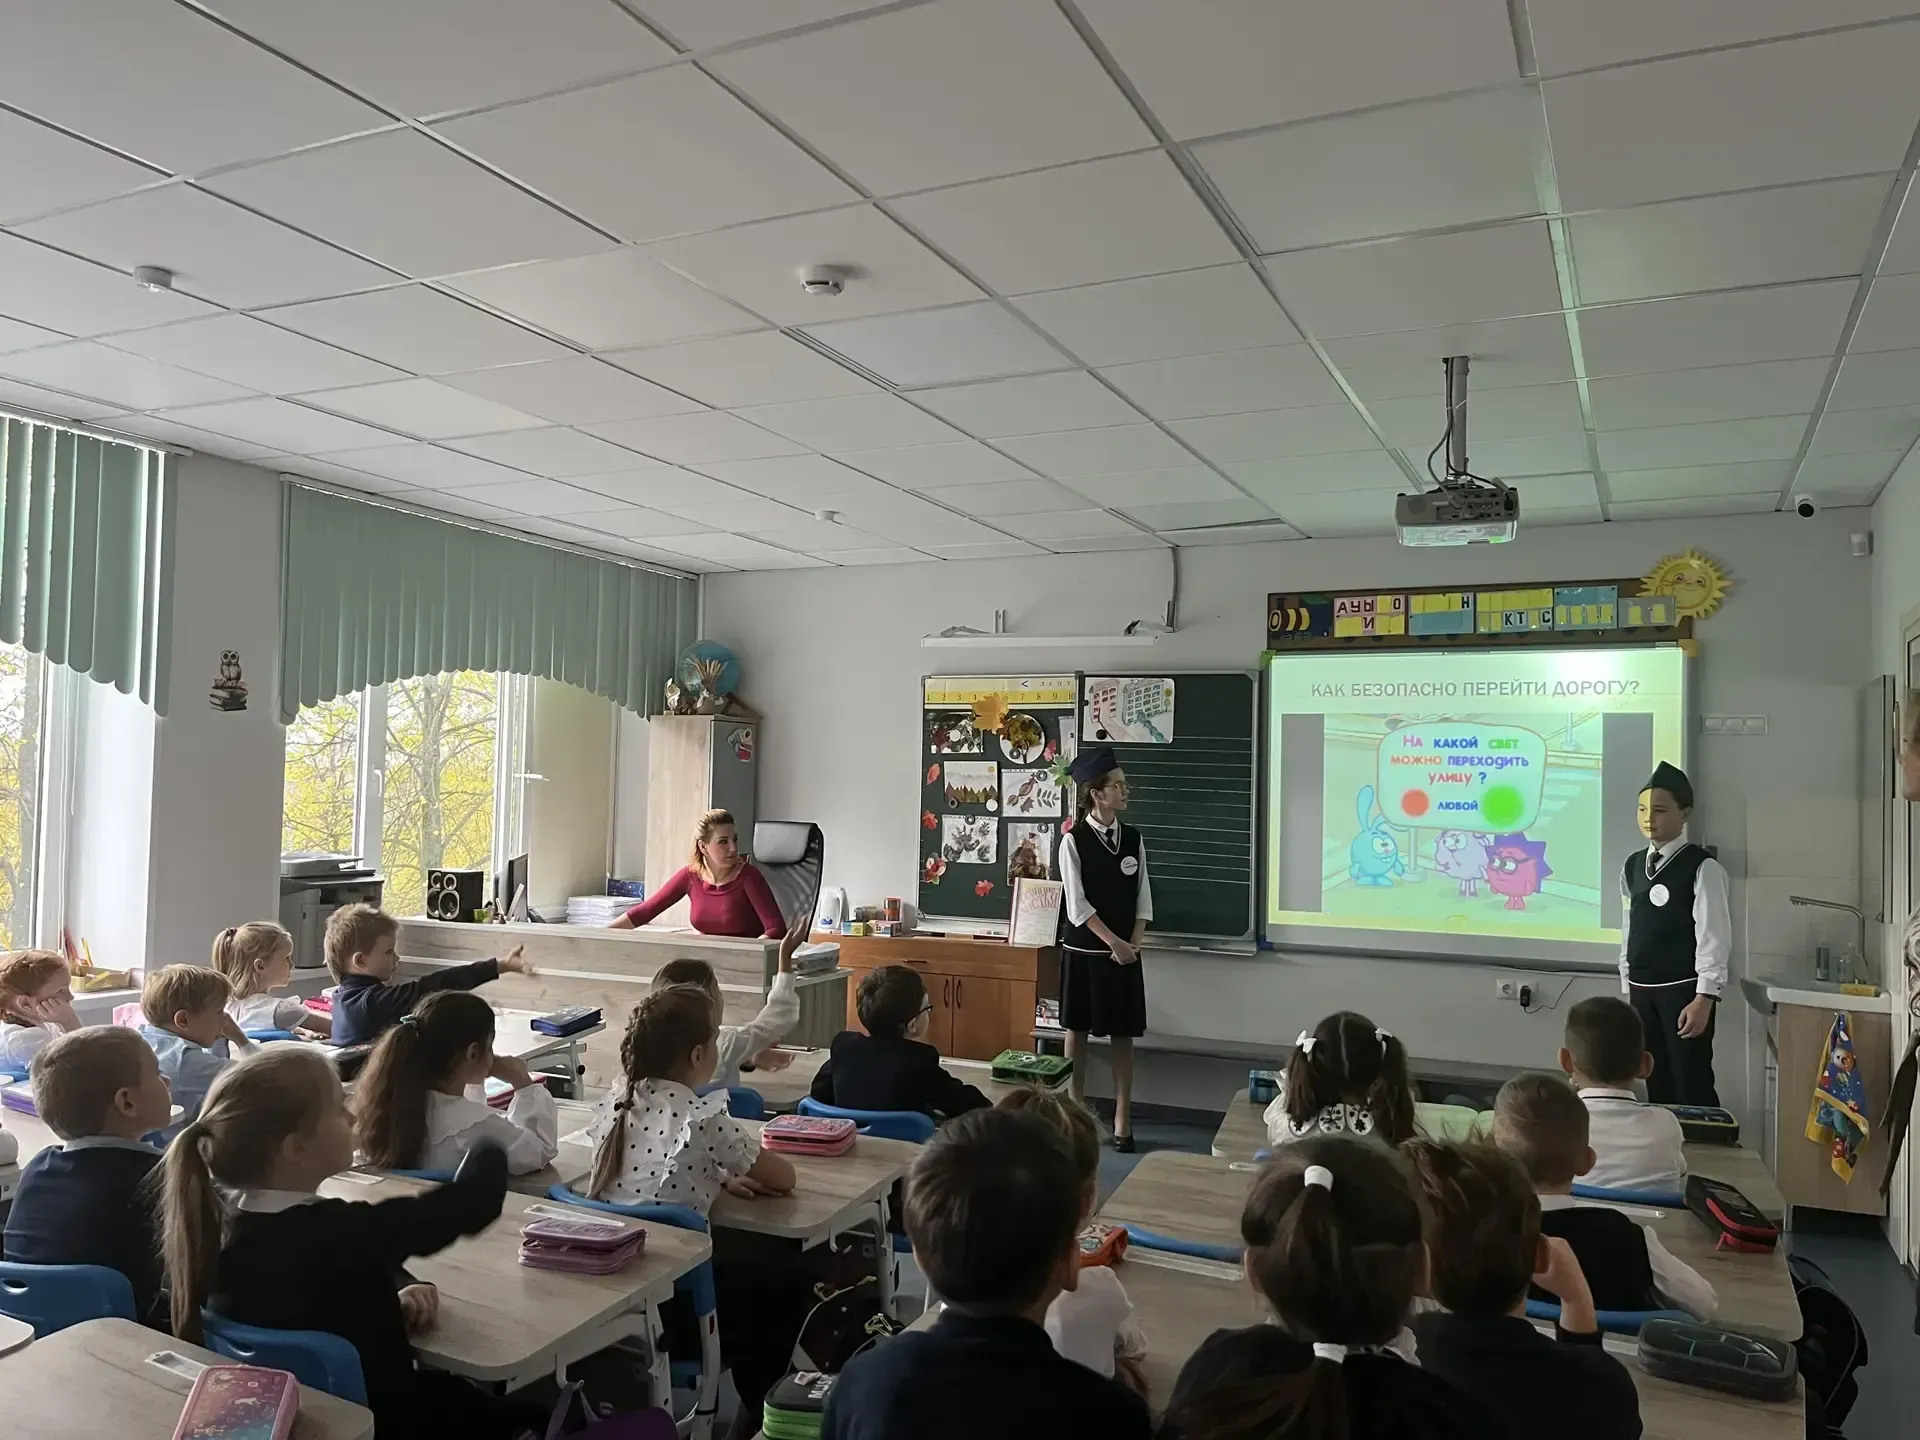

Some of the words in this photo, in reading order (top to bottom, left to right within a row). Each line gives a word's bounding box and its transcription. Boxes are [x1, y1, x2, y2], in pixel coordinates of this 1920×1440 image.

[1312, 683, 1345, 697] КАК
[1351, 682, 1457, 697] БЕЗОПАСНО
[1463, 678, 1547, 696] ПЕРЕЙТИ
[1552, 680, 1640, 698] ДОРОГУ?
[1433, 736, 1478, 749] КАКОЙ
[1488, 738, 1519, 749] СВЕТ
[1390, 755, 1442, 765] МОЖНО
[1447, 755, 1529, 769] ПЕРЕХОДИТЬ
[1428, 772, 1472, 786] УЛИЦУ
[1437, 800, 1478, 811] ЛЮБОЙ
